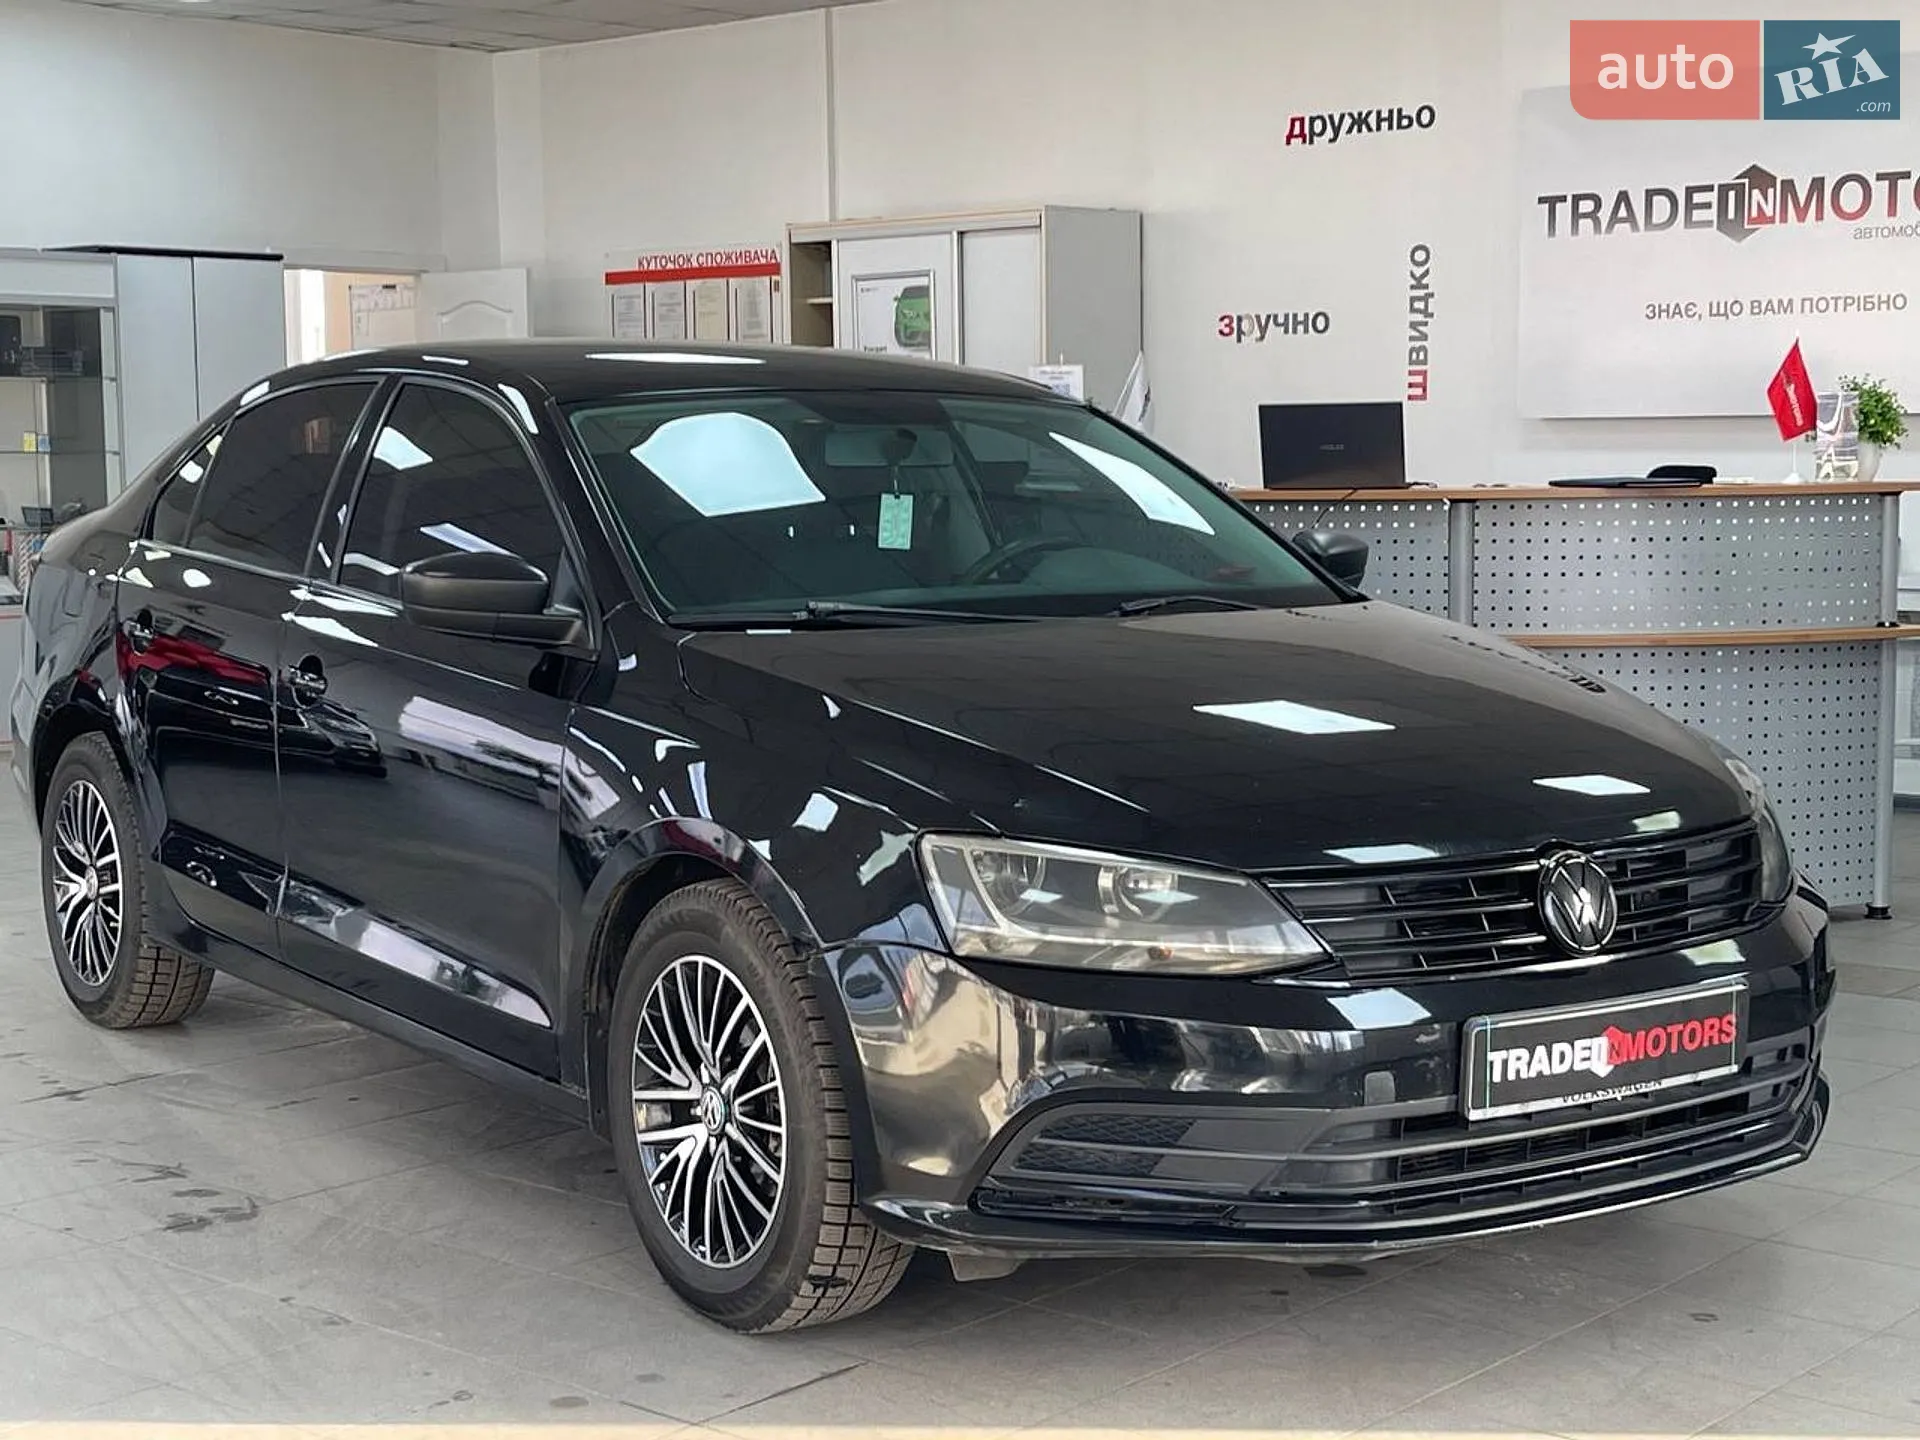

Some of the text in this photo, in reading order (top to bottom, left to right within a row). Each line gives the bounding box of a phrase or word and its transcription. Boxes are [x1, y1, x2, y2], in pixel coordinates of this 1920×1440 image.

[1284, 104, 1436, 146] дружньо
[637, 248, 778, 269] КУТОЧОК СПОЖИВАЧА
[1407, 243, 1435, 401] швидко
[1645, 293, 1908, 321] ЗНАЄ, ЩО ВАМ ПОТРІБНО
[1218, 311, 1331, 344] зручно
